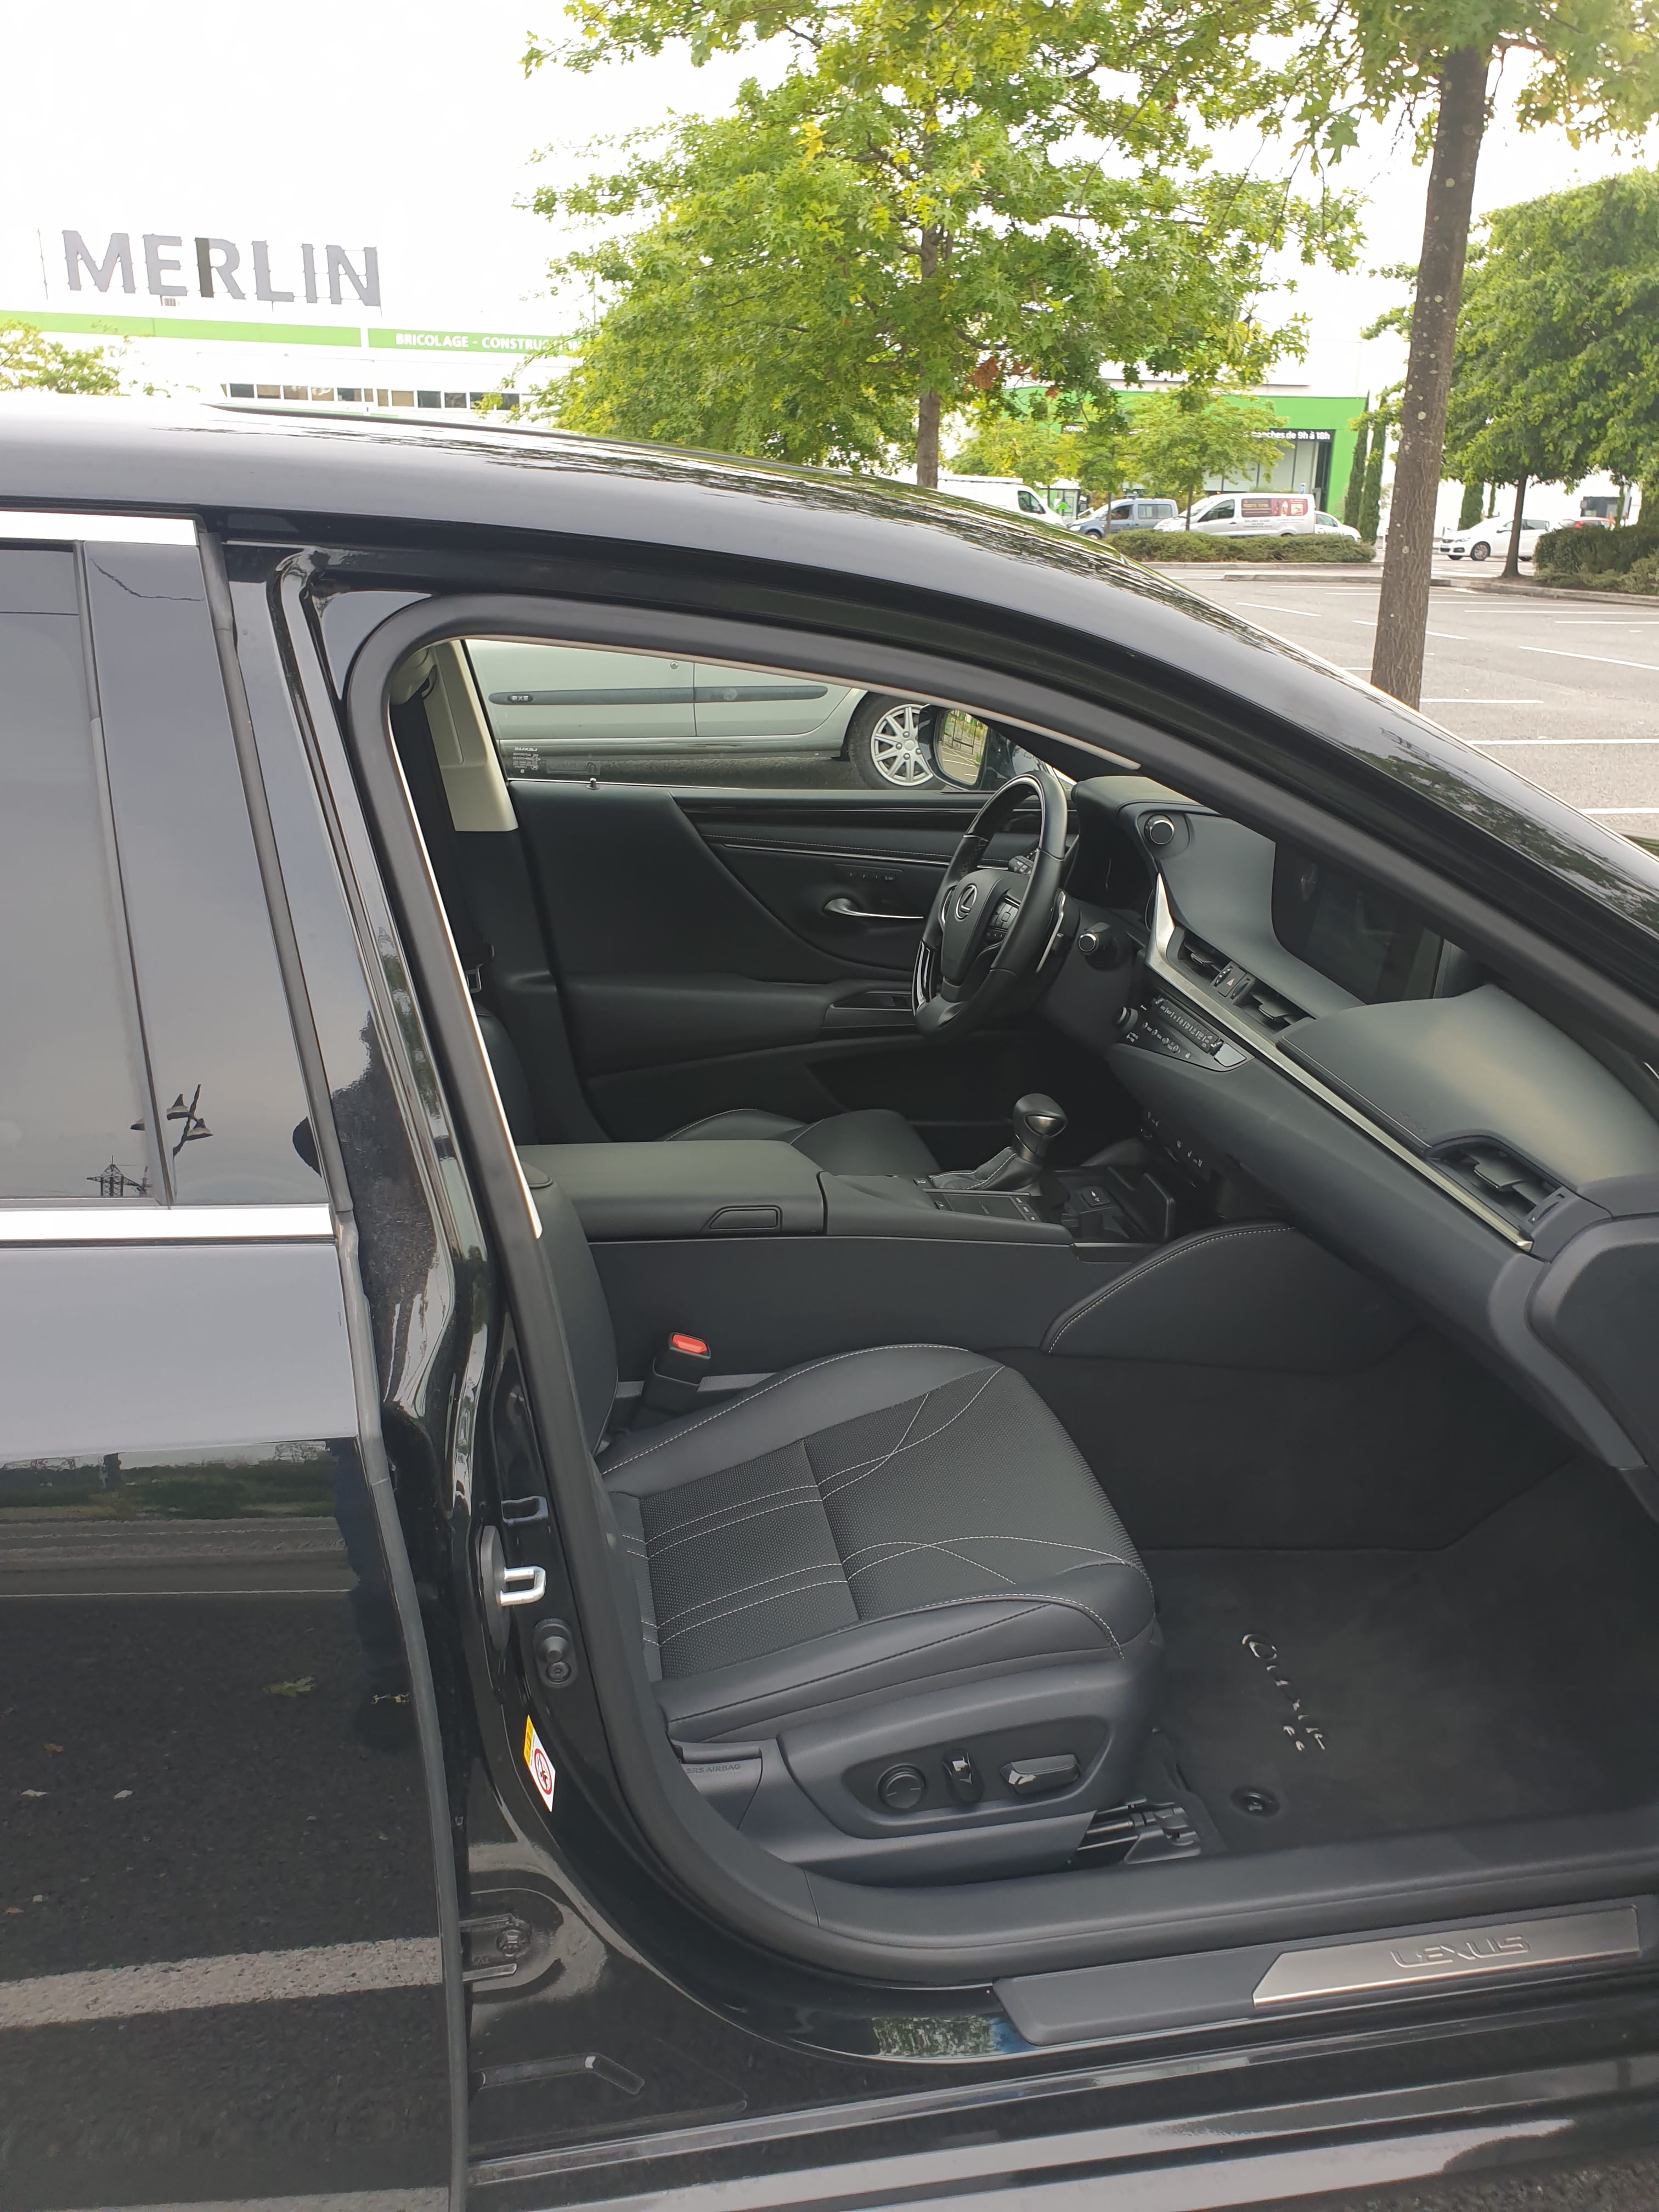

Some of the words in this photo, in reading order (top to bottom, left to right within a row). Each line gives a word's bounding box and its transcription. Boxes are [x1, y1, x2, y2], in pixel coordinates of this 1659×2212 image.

[62, 230, 381, 307] MERLIN
[395, 332, 469, 348] BRICOLAGE
[1285, 430, 1296, 439] de
[705, 1763, 742, 1773] AIRBAG
[1390, 1934, 1531, 1968] LEXUS
